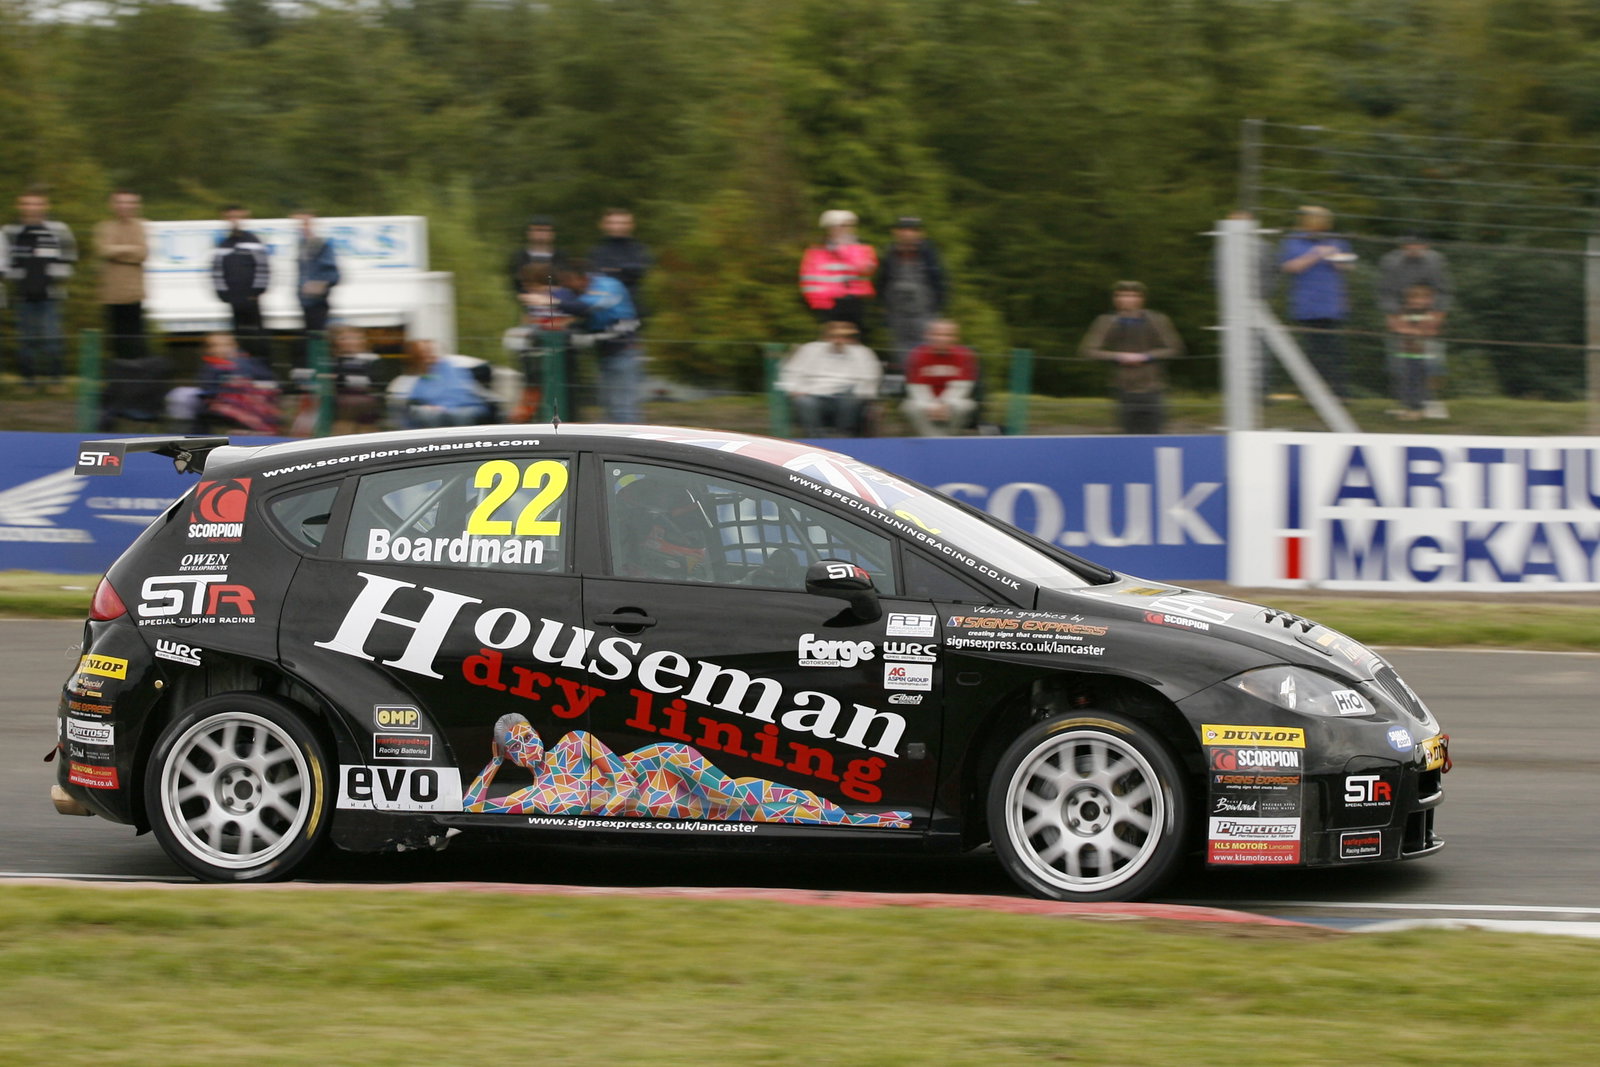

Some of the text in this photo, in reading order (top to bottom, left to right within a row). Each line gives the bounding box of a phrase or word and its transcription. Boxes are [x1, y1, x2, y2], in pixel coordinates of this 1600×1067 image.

[78, 451, 120, 467] STR
[262, 439, 540, 479] www.scorpion-exhausts.com
[467, 459, 569, 537] 22
[188, 523, 243, 538] SCORPION
[366, 528, 544, 564] Boardman
[181, 553, 230, 566] OWEN
[138, 574, 256, 618] STR
[139, 618, 177, 626] SPECIAL
[219, 616, 256, 624] RACING
[1016, 610, 1067, 620] graphics
[1070, 614, 1085, 623] by
[1164, 614, 1209, 631] SCORPION
[963, 617, 1109, 637] SIGNS EXPRESS
[967, 630, 995, 638] creating
[156, 639, 202, 660] WRC
[884, 642, 937, 656] WRC
[946, 635, 1105, 655] signsexpress.co.uk/lancaster
[82, 659, 124, 673] NLOP
[313, 571, 907, 759] Houseman
[888, 667, 906, 677] AG
[1334, 693, 1364, 710] HiQ
[378, 710, 418, 725] OMP
[462, 648, 888, 803] dry lining
[1222, 730, 1300, 742] DUNLOP
[379, 747, 427, 755] Racing Batteries
[1238, 749, 1299, 768] SCORPION
[347, 766, 438, 803] evo
[1344, 775, 1393, 803] STR
[528, 817, 758, 833] www.signsexpress.co.uk/lancaster
[1216, 820, 1297, 837] Pipercross
[1214, 842, 1230, 850] KLS
[1231, 842, 1268, 850] MOTORS
[1213, 853, 1293, 862] www.klsmotors.co.uk
